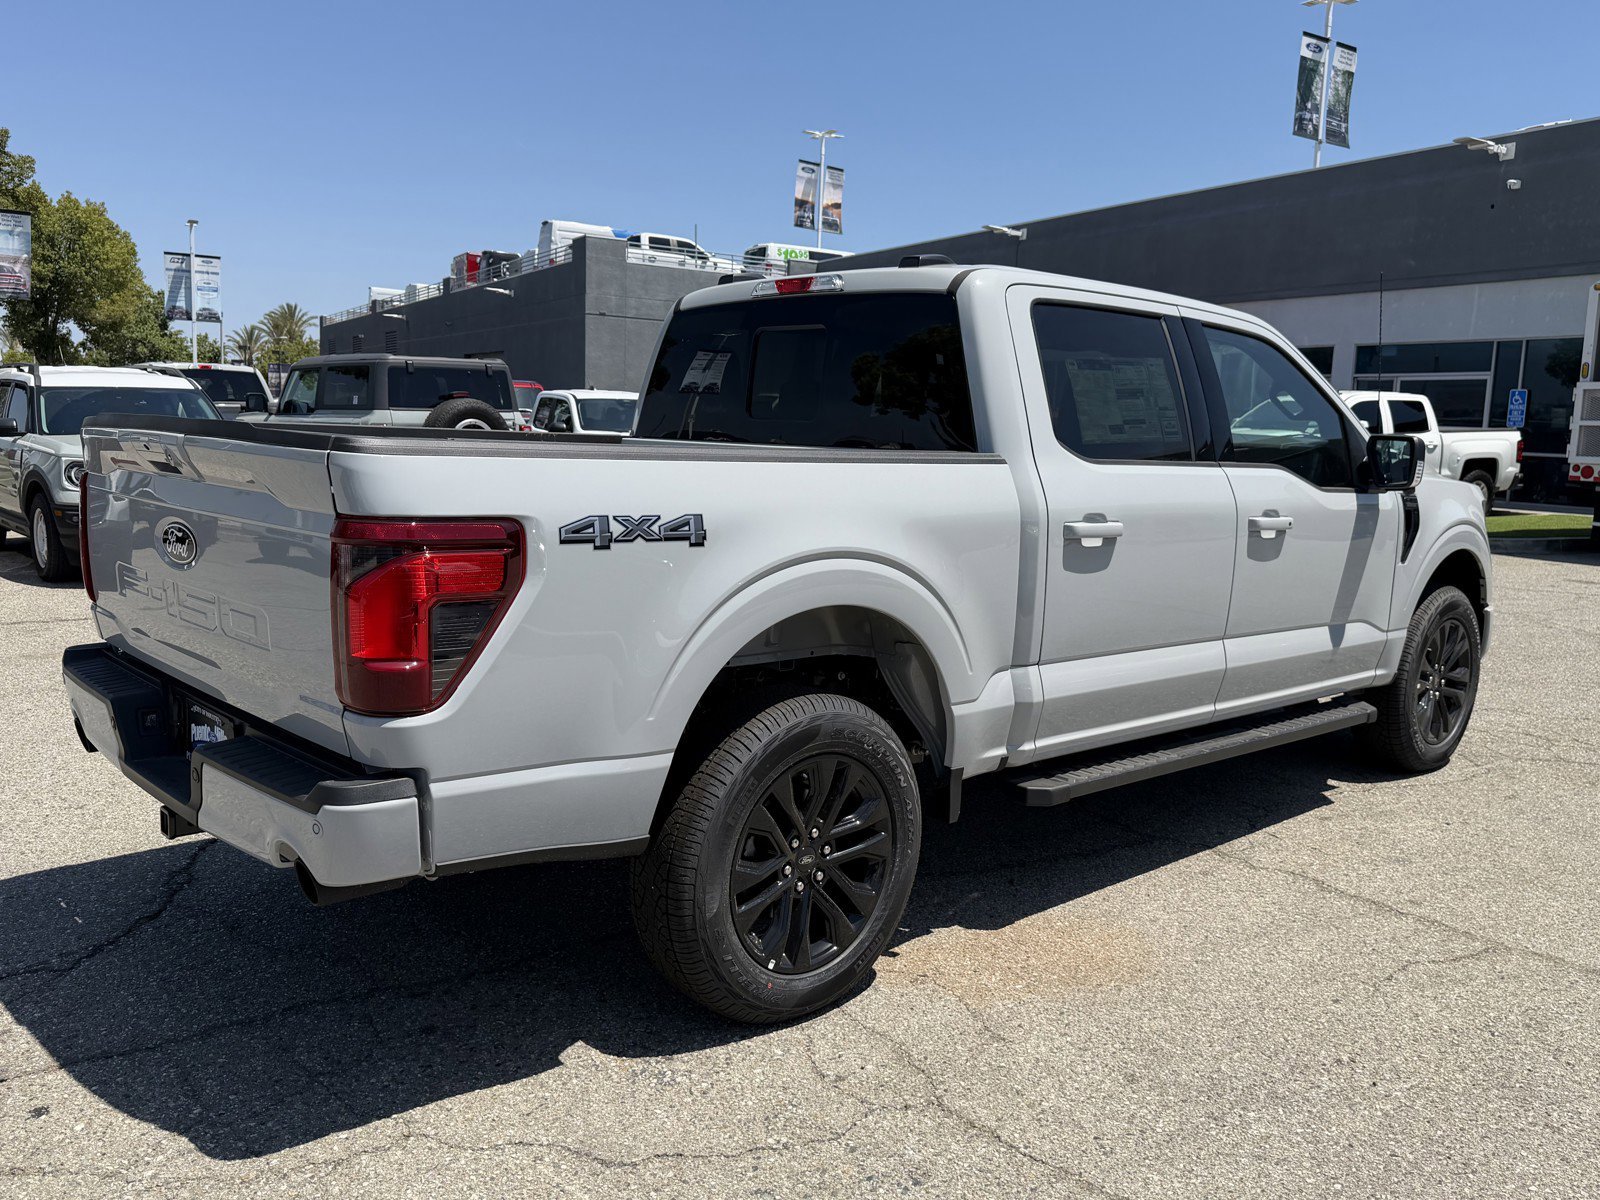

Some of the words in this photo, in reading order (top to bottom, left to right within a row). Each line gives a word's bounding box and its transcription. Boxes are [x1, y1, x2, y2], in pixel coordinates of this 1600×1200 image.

[165, 528, 194, 559] Ford
[116, 561, 272, 652] F-150
[830, 726, 908, 790] SCORPION
[721, 949, 786, 1005] PIRELLI
